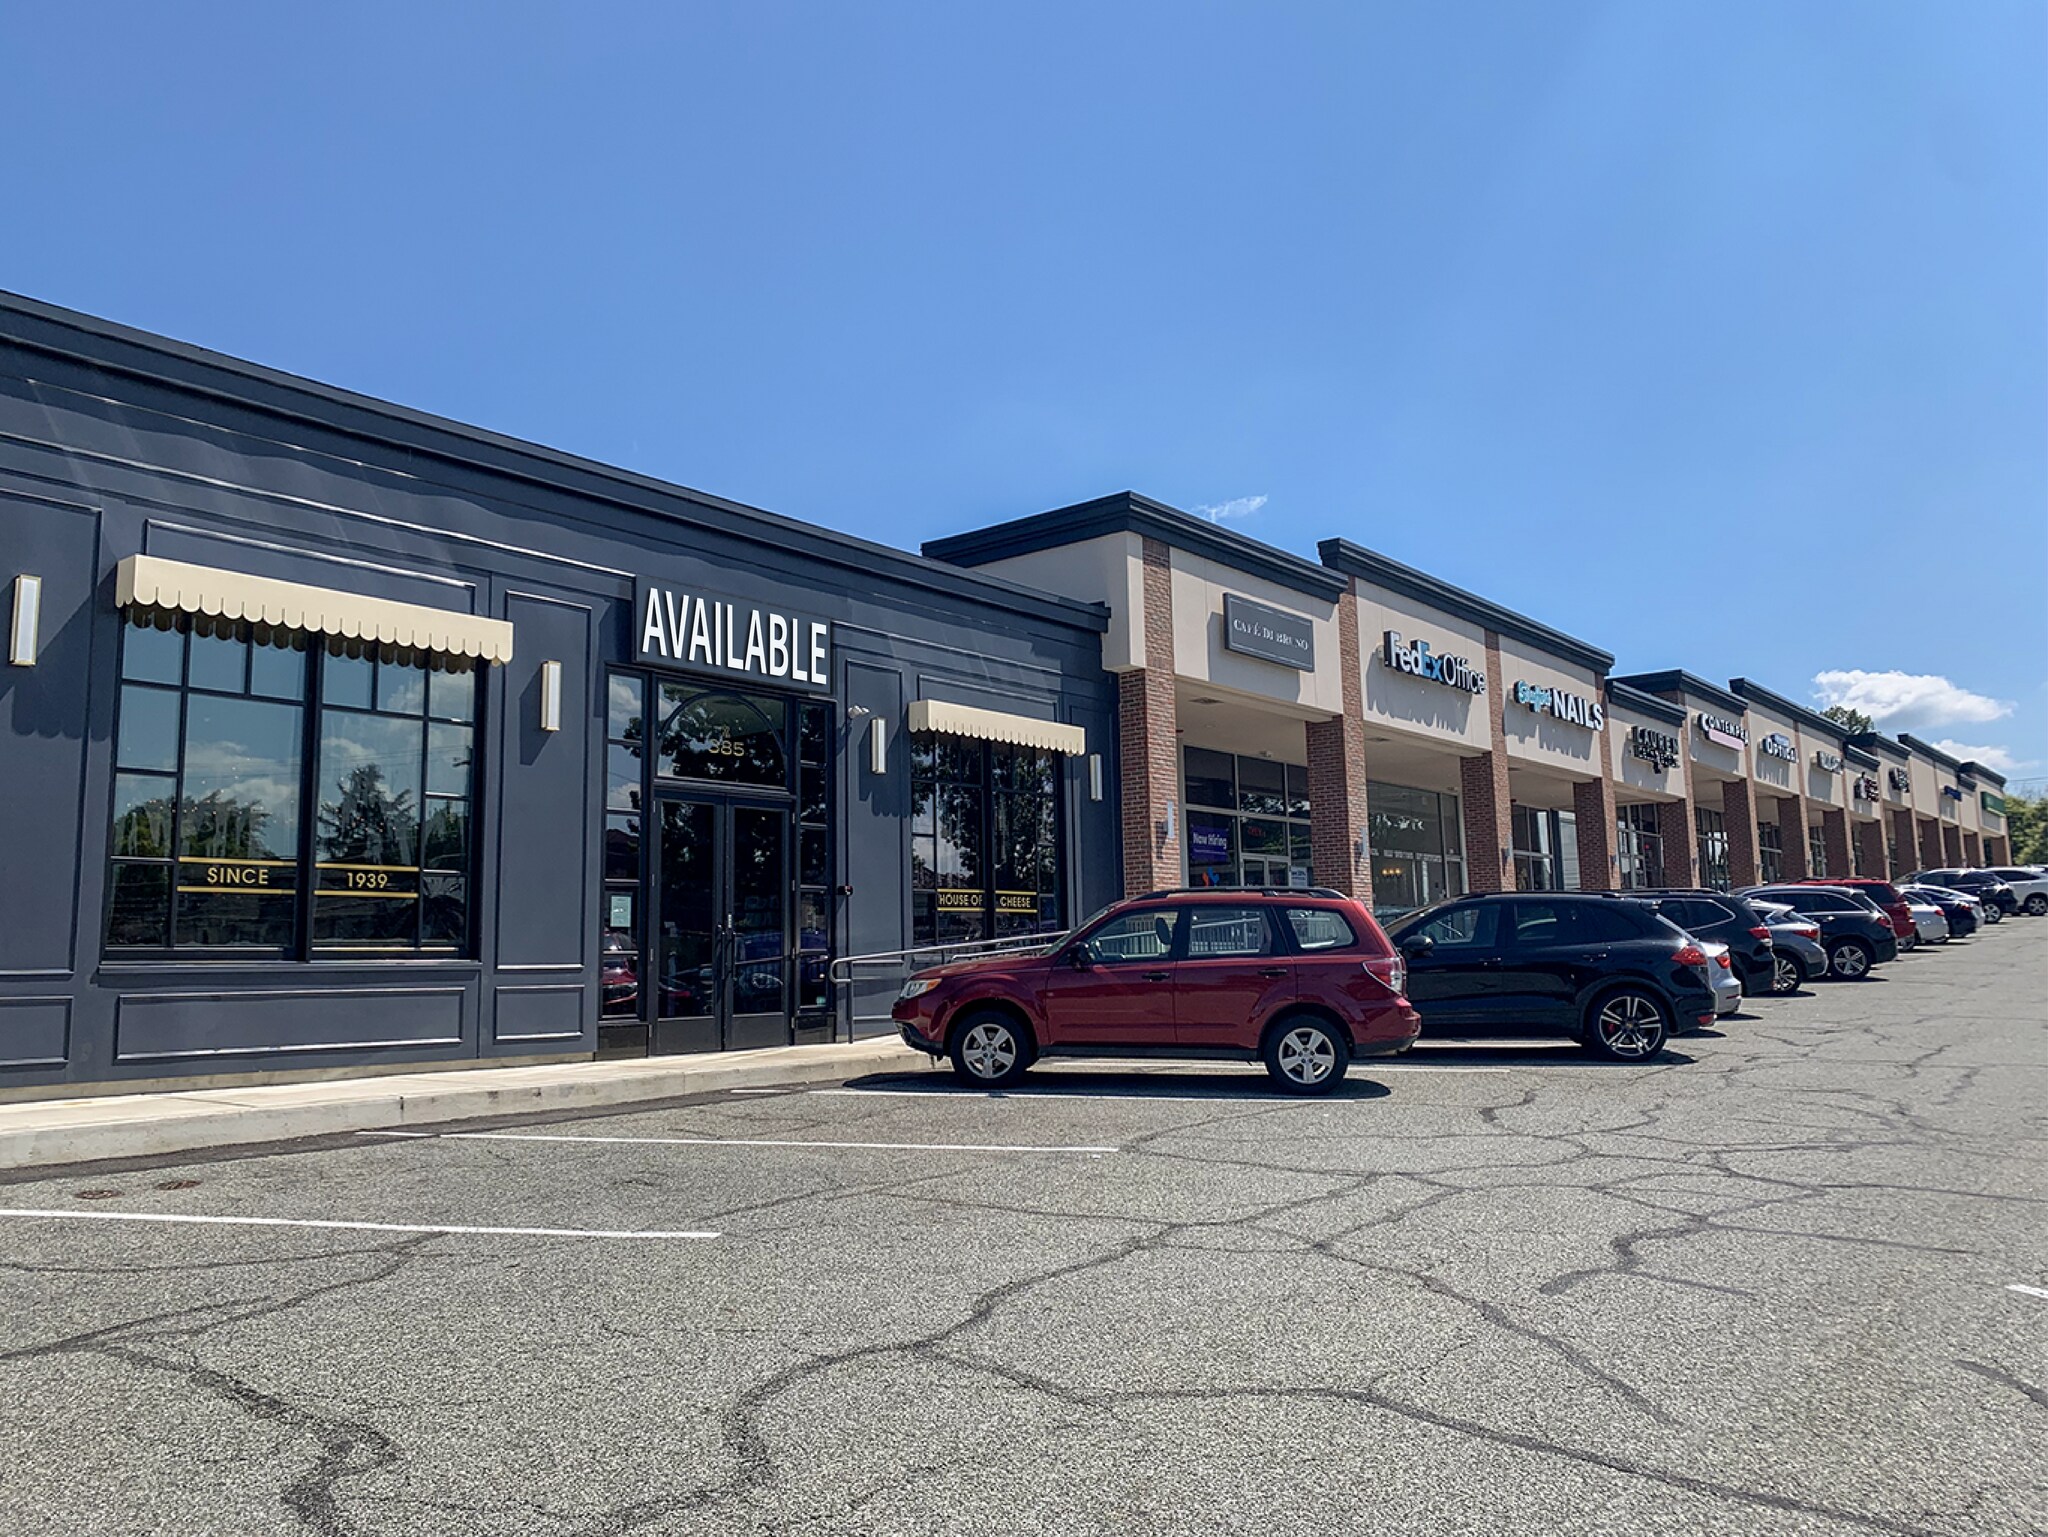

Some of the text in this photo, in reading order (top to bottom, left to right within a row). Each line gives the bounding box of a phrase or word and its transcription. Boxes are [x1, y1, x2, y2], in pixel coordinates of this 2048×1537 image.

[642, 587, 827, 685] AVAILABLE
[1263, 627, 1274, 641] DI
[1387, 630, 1486, 695] FedEx Office
[1551, 687, 1604, 732] NAILS
[1193, 831, 1227, 850] Now Hiring
[207, 867, 269, 884] SINCE
[347, 872, 388, 888] 1939
[940, 894, 983, 906] HOUSE OF
[1000, 896, 1031, 908] CHEESE
